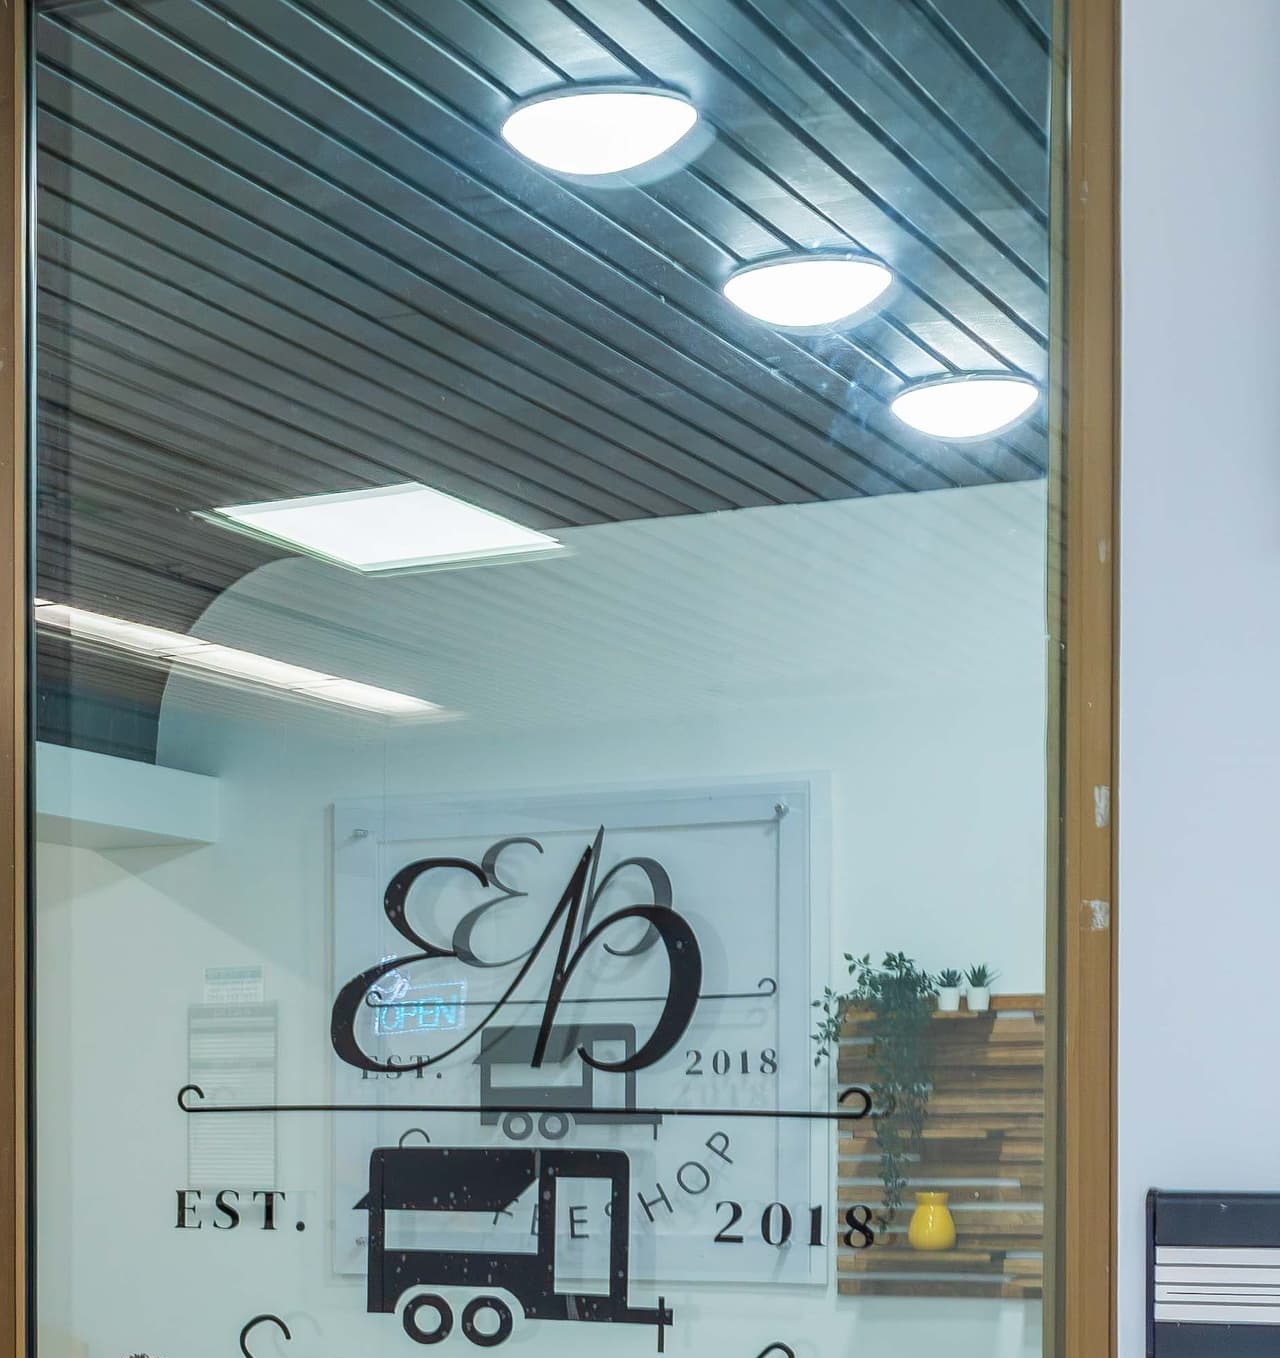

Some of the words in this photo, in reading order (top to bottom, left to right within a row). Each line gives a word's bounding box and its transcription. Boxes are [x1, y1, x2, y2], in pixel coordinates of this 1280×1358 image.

[380, 994, 457, 1030] OPEN
[685, 1047, 778, 1076] 2018
[174, 1188, 306, 1232] EST.
[713, 1200, 875, 1249] 2018
